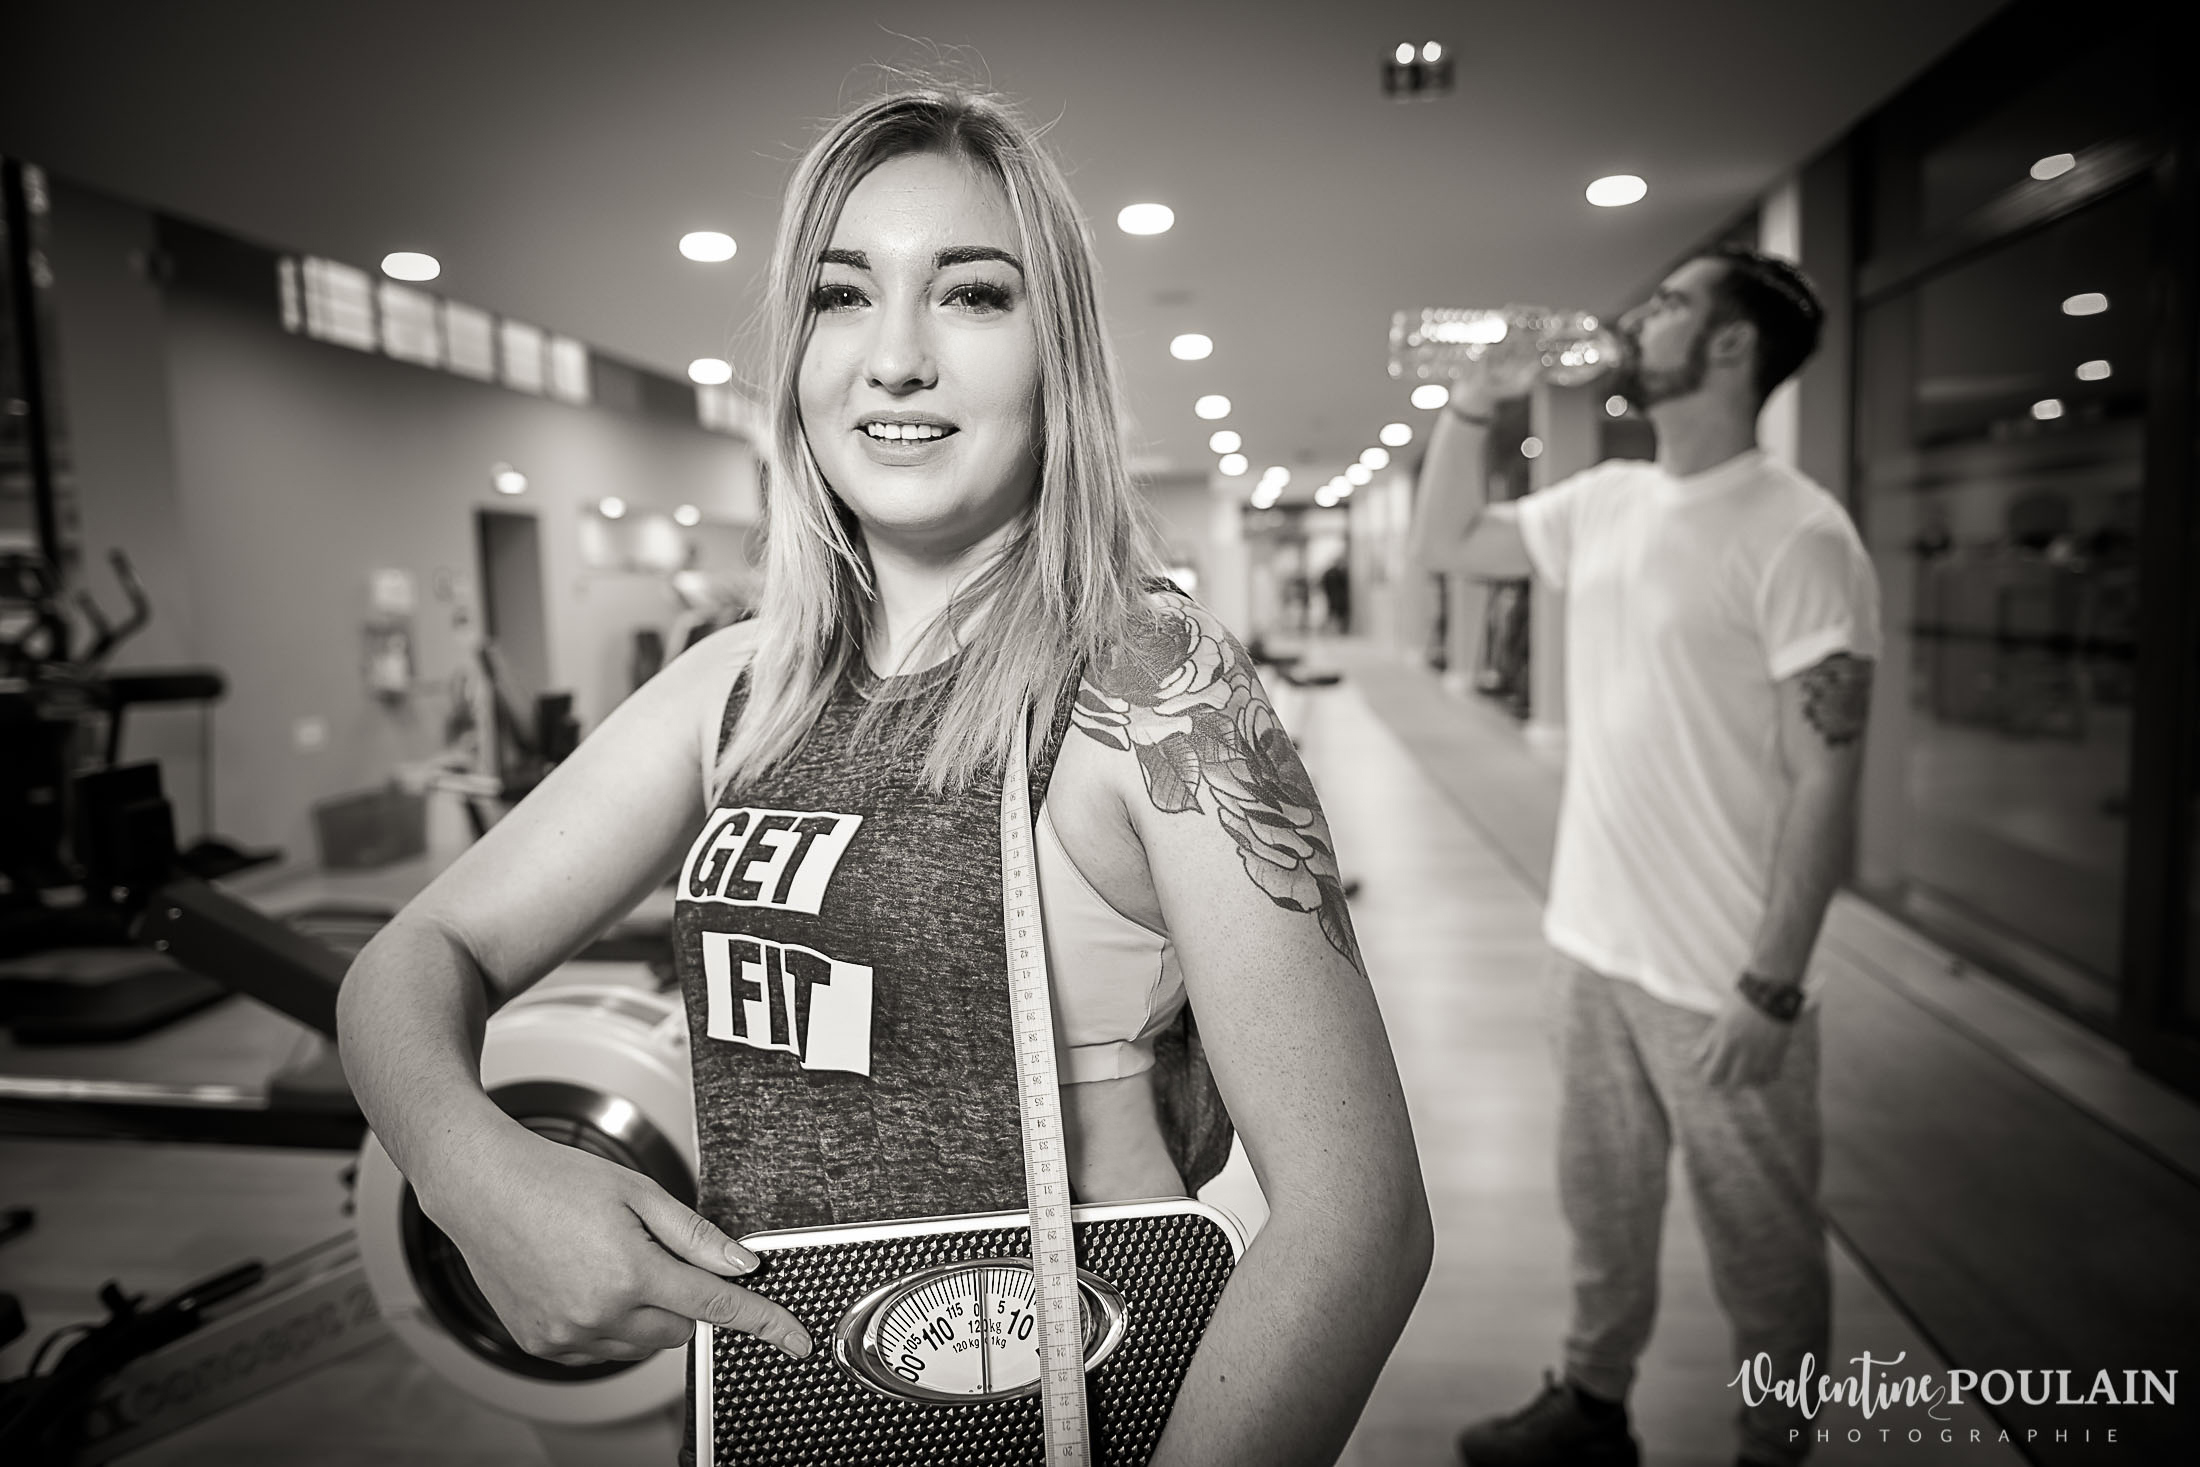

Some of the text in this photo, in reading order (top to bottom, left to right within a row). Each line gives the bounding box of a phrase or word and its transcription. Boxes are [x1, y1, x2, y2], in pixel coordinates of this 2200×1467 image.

[689, 811, 840, 905] GET
[1013, 870, 1021, 878] 46
[1015, 890, 1023, 898] 45
[1017, 910, 1024, 918] 44
[1018, 930, 1027, 938] 43
[1020, 950, 1029, 959] 42
[1022, 970, 1031, 979] 41
[1024, 991, 1033, 1000] 40
[728, 939, 832, 1064] FIT
[1026, 1012, 1036, 1021] 39
[1028, 1033, 1038, 1042] 38
[1031, 1054, 1040, 1063] 37
[1032, 1075, 1042, 1085] 36
[1034, 1097, 1044, 1106] 35
[1037, 1119, 1046, 1128] 34
[1038, 1141, 1049, 1150] 33
[1041, 1163, 1051, 1172] 32
[1043, 1185, 1052, 1195] 31
[1045, 1208, 1055, 1217] 30
[1047, 1230, 1057, 1240] 29
[1049, 1254, 1059, 1263] 28
[1051, 1276, 1060, 1287] 27
[973, 1302, 980, 1317] 0
[997, 1300, 1006, 1314] 5
[1052, 1299, 1063, 1310] 26
[945, 1302, 963, 1319] 115
[1007, 1309, 1034, 1340] 10
[1054, 1324, 1065, 1334] 25
[922, 1316, 954, 1351] 110
[902, 1333, 922, 1354] 105
[1056, 1347, 1066, 1357] 24
[894, 1354, 926, 1383] 00
[1058, 1371, 1068, 1382] 23
[1060, 1396, 1070, 1406] 22
[1062, 1420, 1071, 1431] 21
[1063, 1445, 1073, 1457] 20
